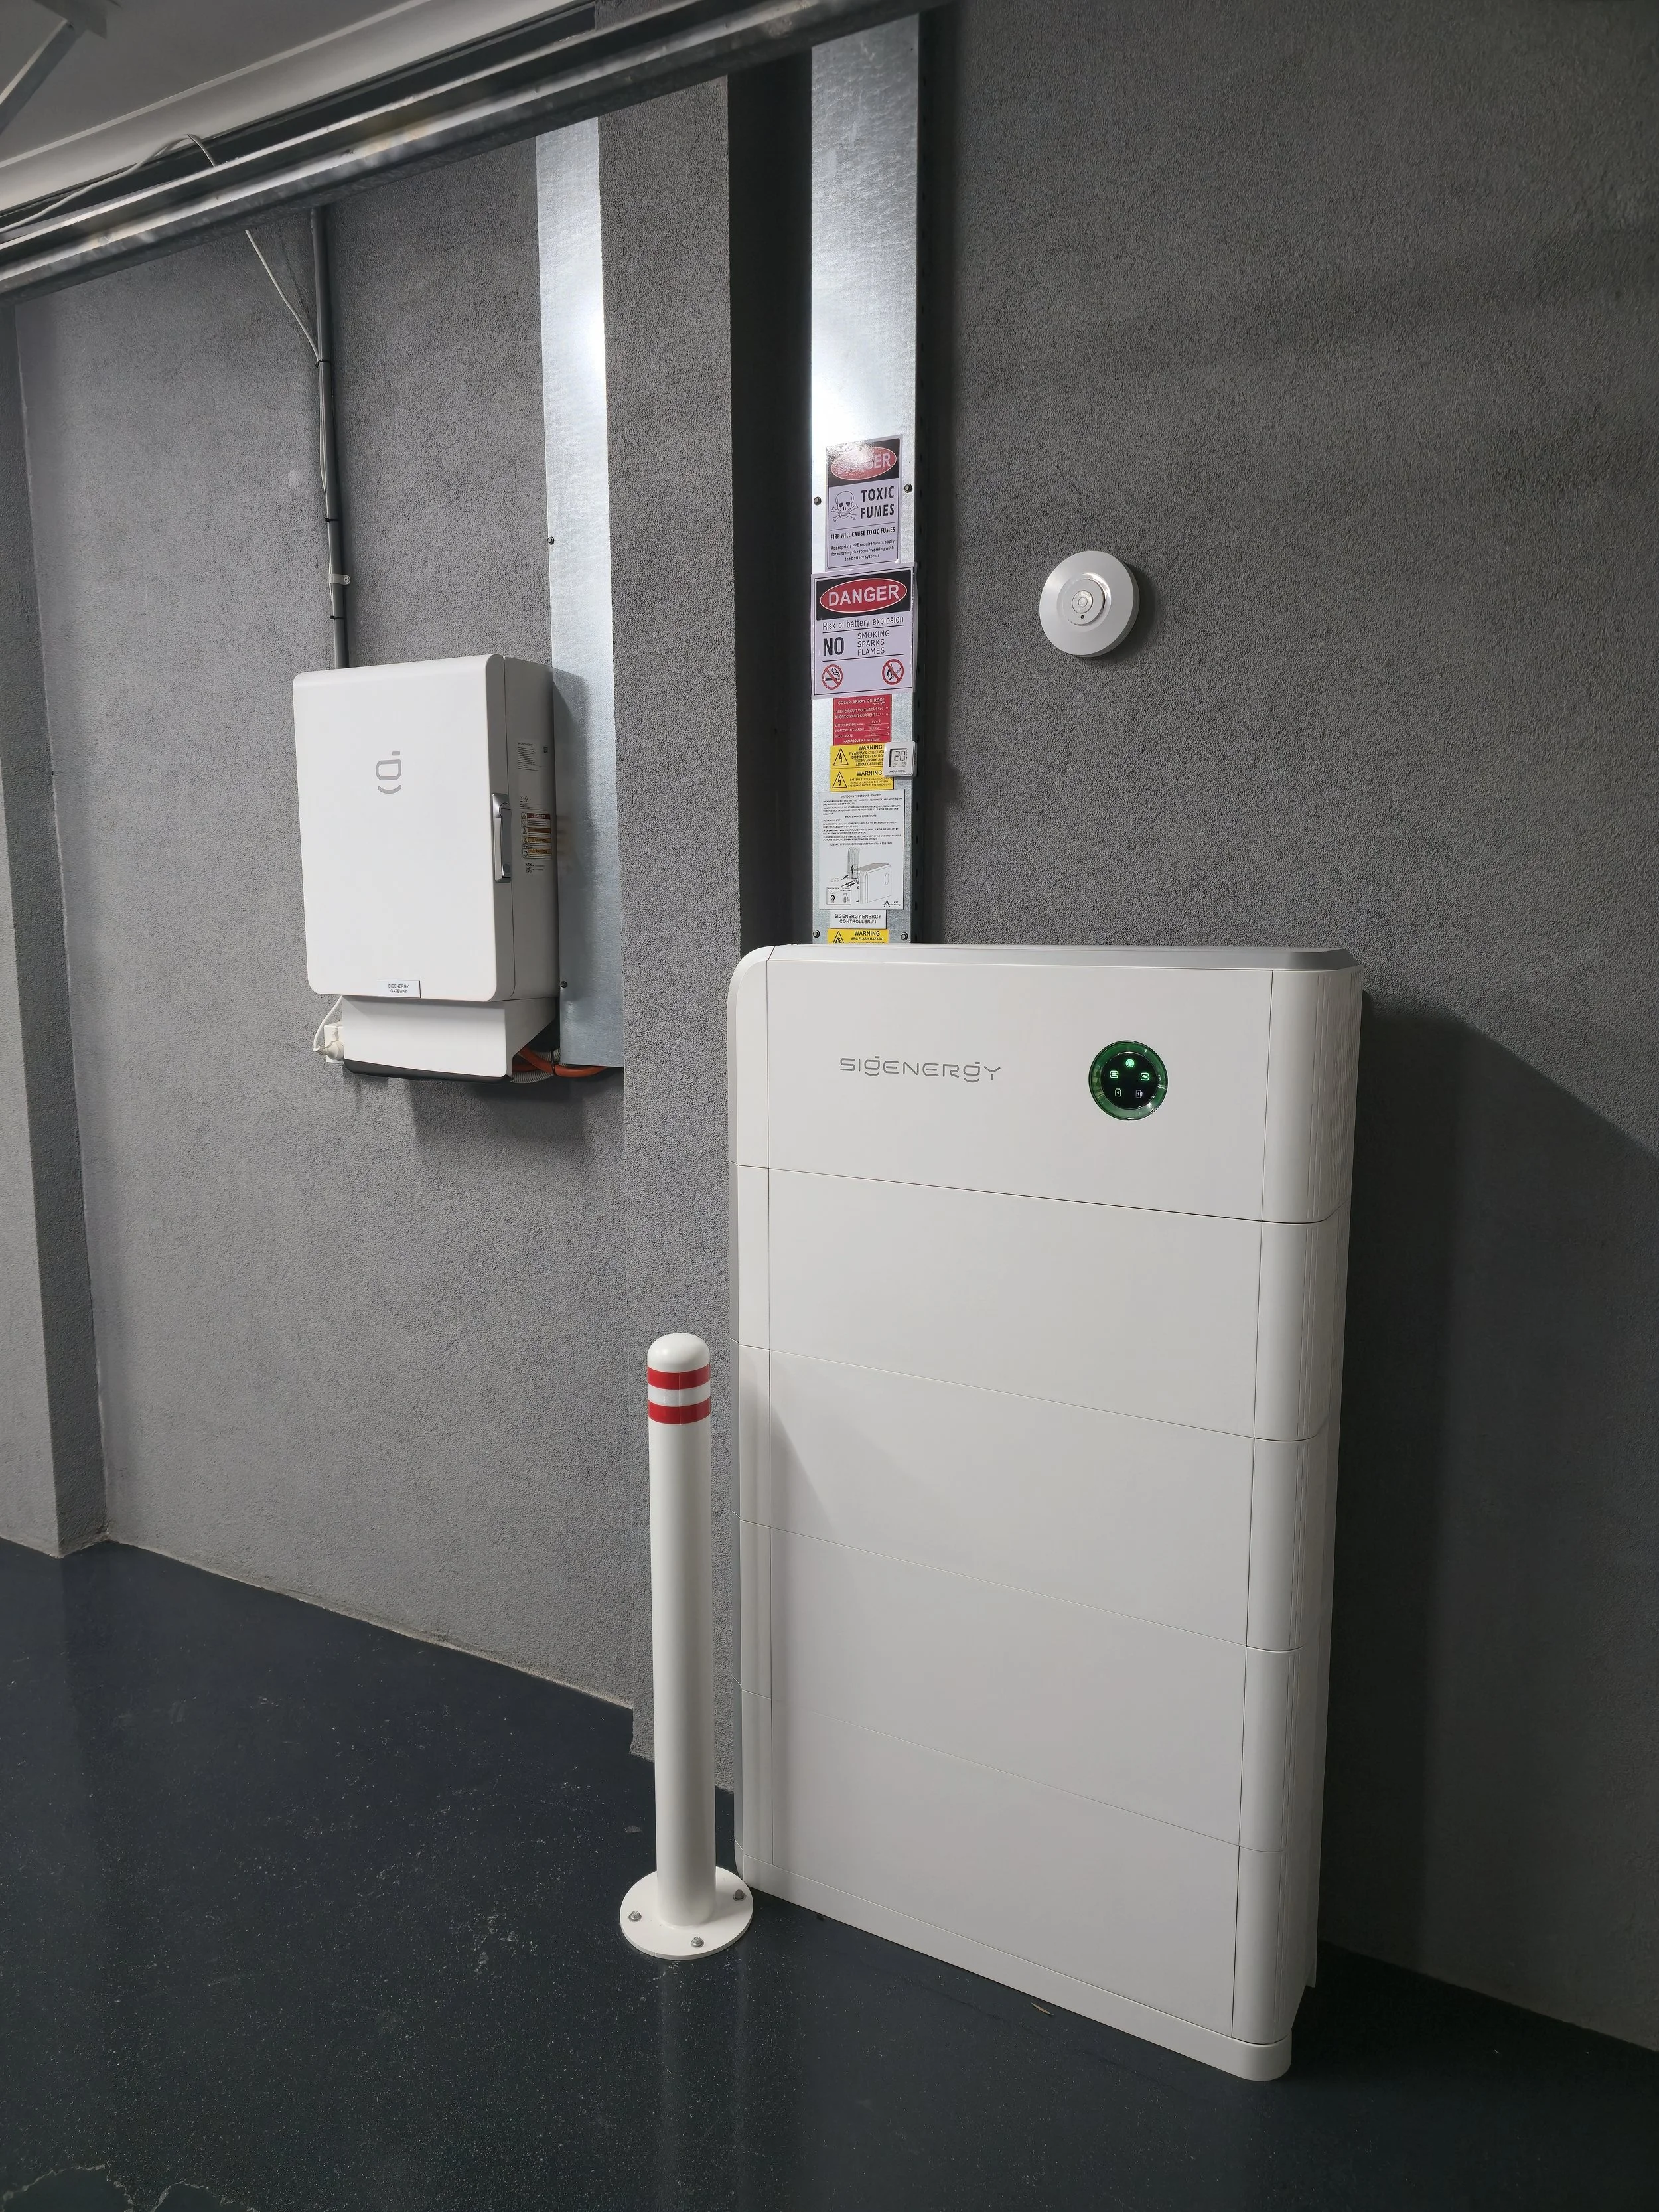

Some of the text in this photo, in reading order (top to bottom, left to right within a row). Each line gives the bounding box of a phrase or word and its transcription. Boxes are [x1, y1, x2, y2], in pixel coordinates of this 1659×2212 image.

[861, 486, 895, 502] TOXIC
[860, 503, 895, 519] FUMES
[829, 585, 900, 607] DANGER
[822, 615, 904, 630] Risk of battery explosion
[857, 630, 890, 640] SMOKING
[823, 636, 844, 656] NO
[857, 638, 885, 648] SPARKS
[857, 647, 885, 656] FLAMES
